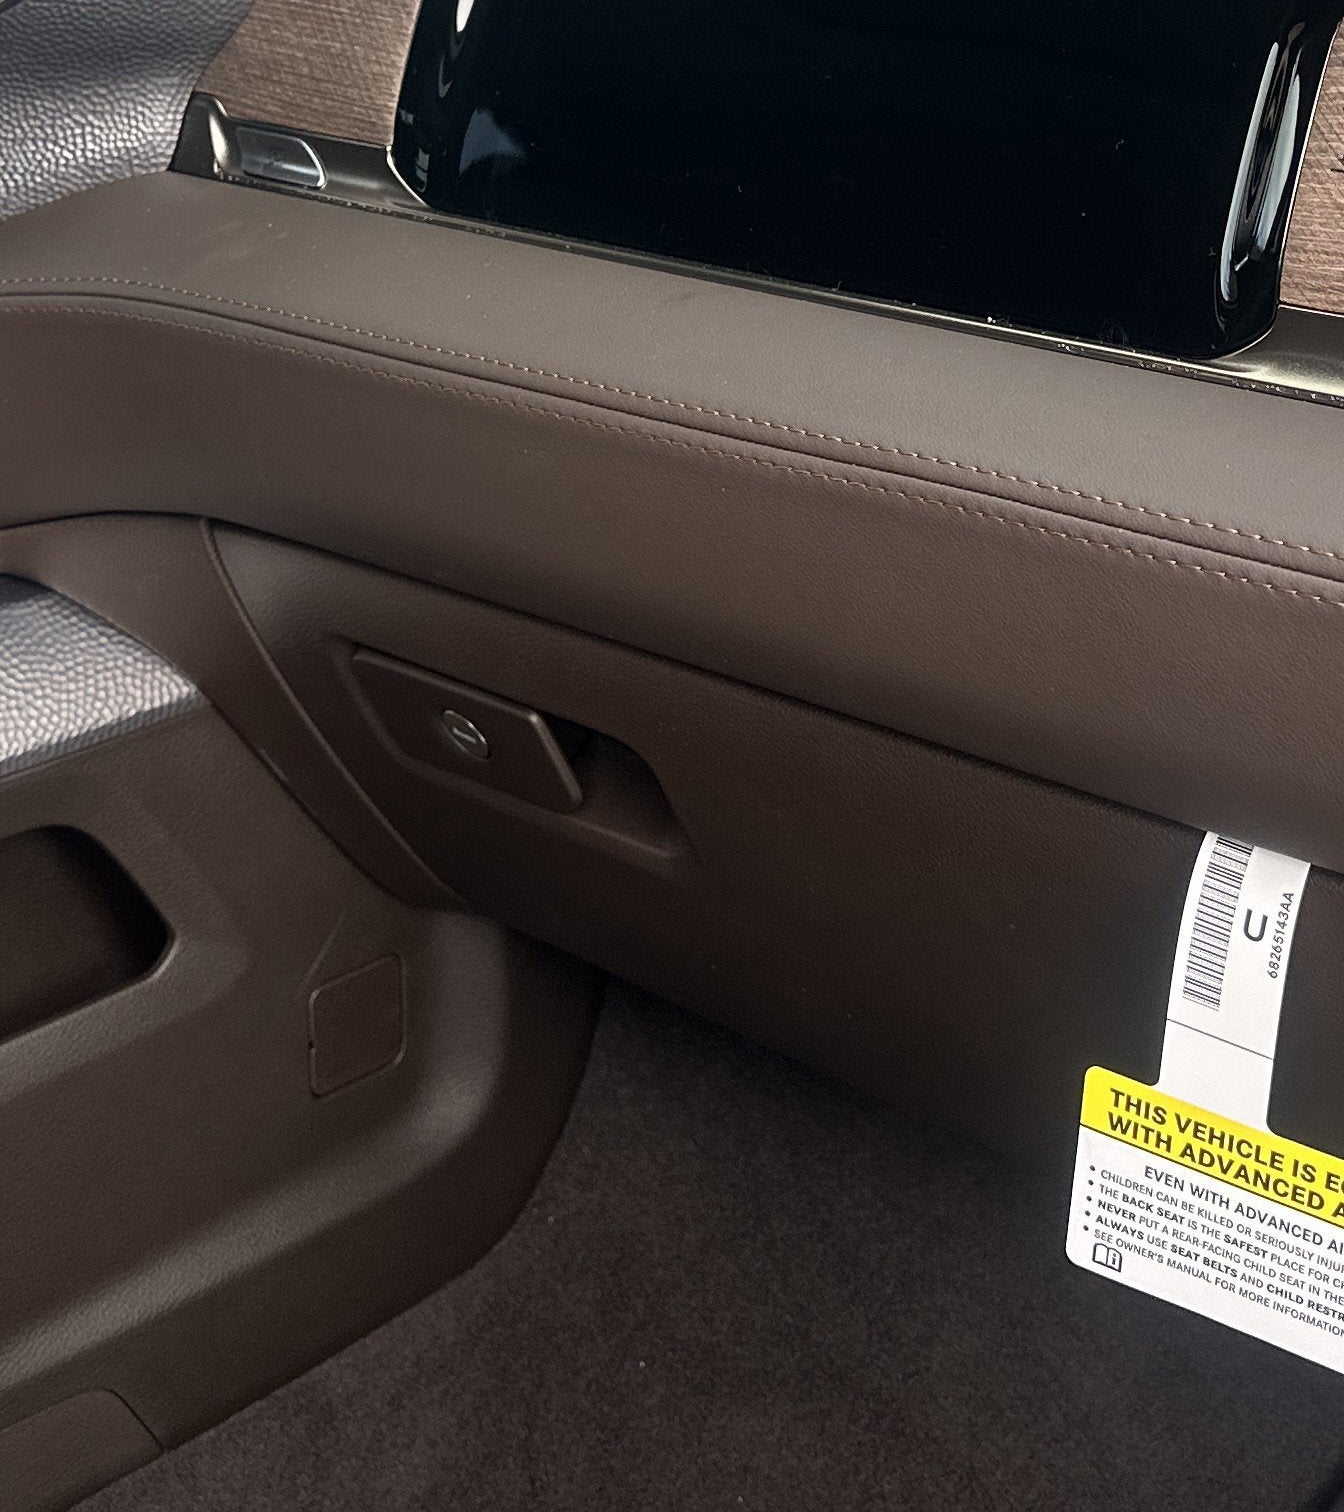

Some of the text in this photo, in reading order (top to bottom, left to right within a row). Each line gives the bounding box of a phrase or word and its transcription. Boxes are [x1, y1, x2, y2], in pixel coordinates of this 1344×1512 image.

[1244, 908, 1268, 942] U
[1267, 893, 1294, 979] 68265143AA
[1108, 1111, 1172, 1153] WITH
[1179, 1142, 1325, 1210] ADVANCED
[1110, 1087, 1167, 1126] THIS
[1174, 1112, 1285, 1173] VEHICLE
[1292, 1159, 1317, 1183] IS
[1099, 1183, 1120, 1201] THE
[1121, 1192, 1154, 1214] BACK
[1156, 1206, 1186, 1225] SEAT
[1187, 1218, 1198, 1231] IS
[1200, 1223, 1221, 1241] THE
[1223, 1233, 1269, 1259] SAFEST
[1270, 1252, 1305, 1275] PLACE
[1307, 1267, 1330, 1285] FOR
[1100, 1169, 1154, 1198] CHILDREN
[1155, 1191, 1179, 1208] CAN
[1180, 1200, 1195, 1214] BE
[1197, 1206, 1234, 1229] KILLED
[1236, 1223, 1252, 1238] OR
[1254, 1230, 1315, 1262] SERIOUSLY
[1144, 1165, 1185, 1192] EVEN
[1189, 1182, 1230, 1210] WITH
[1233, 1202, 1323, 1246] ADVANCED
[1094, 1228, 1114, 1244] SEE
[1115, 1237, 1164, 1264] OWNER'S
[1166, 1257, 1212, 1284] MANUAL
[1214, 1276, 1236, 1294] FOR
[1238, 1286, 1271, 1308] MORE
[1095, 1214, 1145, 1241] ALWAYS
[1146, 1234, 1169, 1251] USE
[1170, 1243, 1201, 1262] SEAT
[1202, 1256, 1238, 1278] BELTS
[1239, 1272, 1264, 1289] AND
[1266, 1283, 1304, 1305] CHILD
[1097, 1198, 1137, 1223] NEVER
[1138, 1215, 1161, 1231] PUT
[1161, 1224, 1169, 1236] A
[1171, 1228, 1241, 1264] REAR-FACING
[1243, 1258, 1277, 1278] CHILD
[1278, 1272, 1307, 1290] SEAT
[1308, 1283, 1321, 1297] IN
[1323, 1289, 1344, 1306] THE
